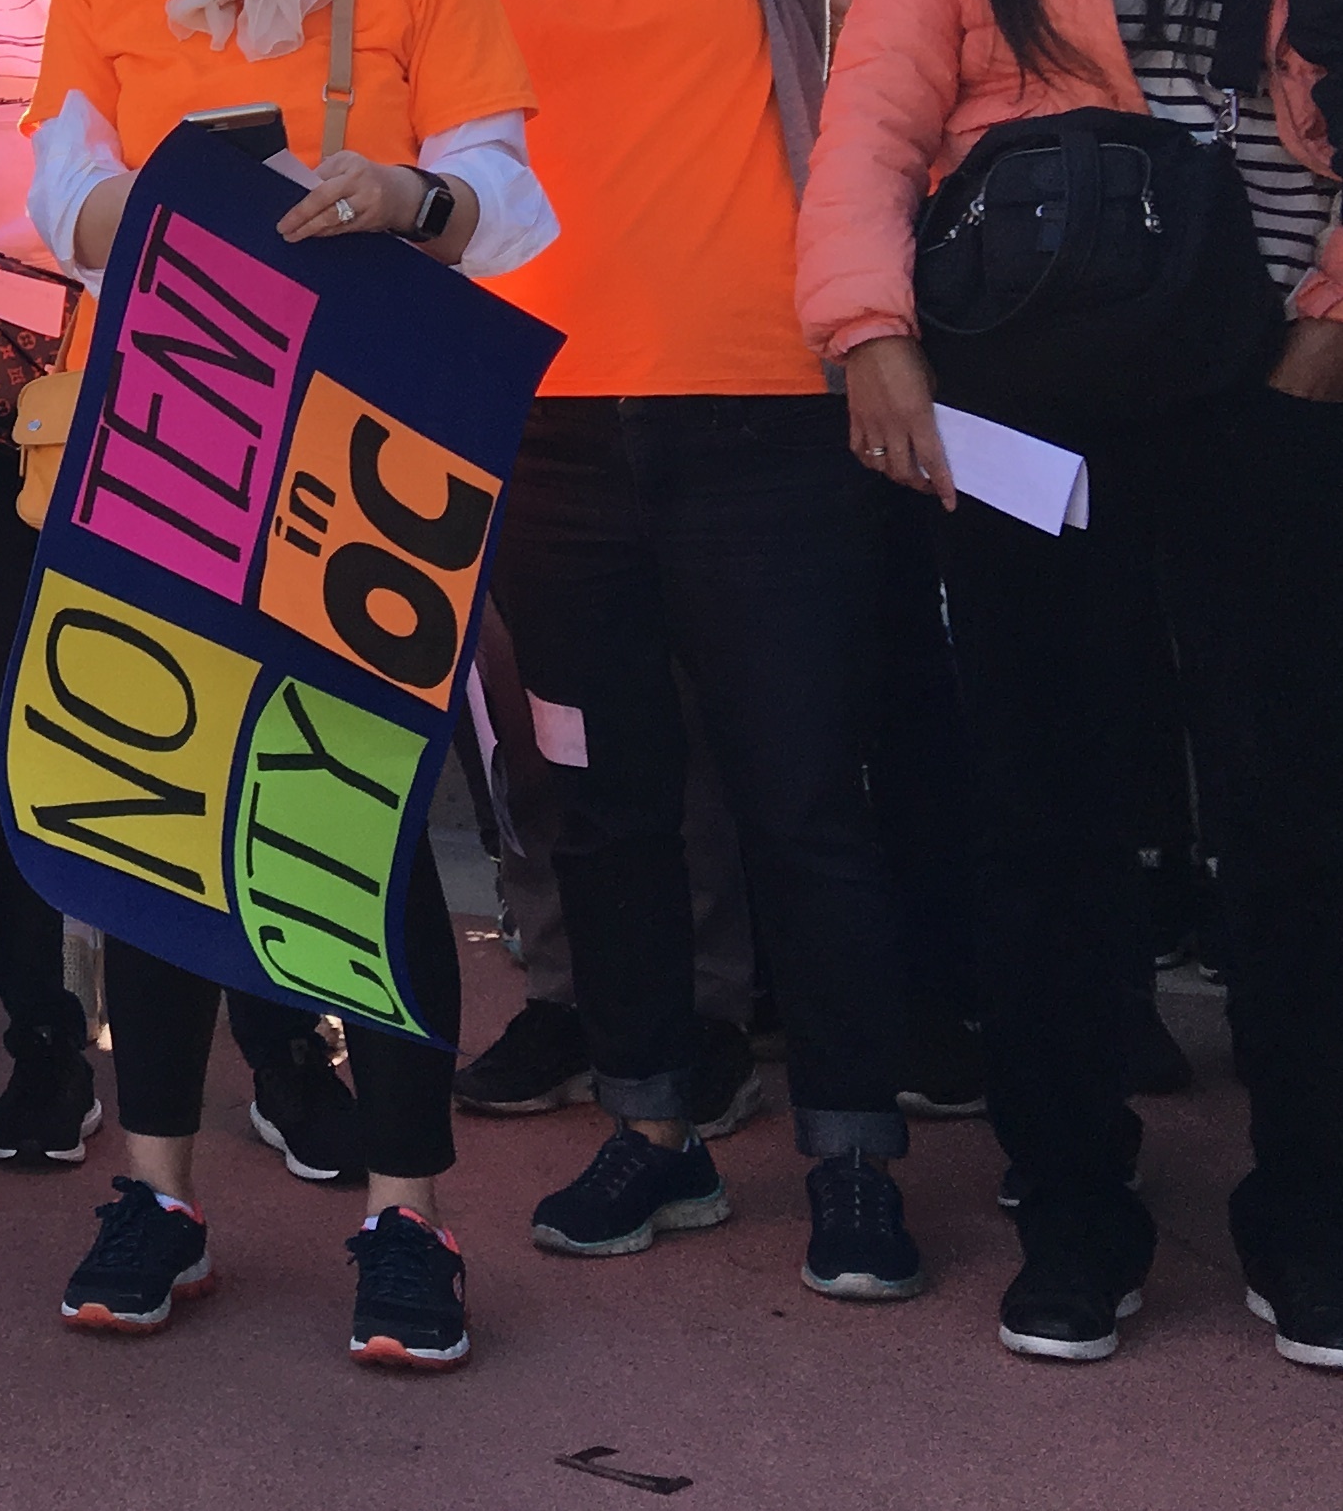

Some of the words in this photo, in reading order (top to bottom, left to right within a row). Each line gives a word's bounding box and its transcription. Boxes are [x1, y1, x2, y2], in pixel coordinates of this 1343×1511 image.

[79, 203, 290, 563] TENT
[275, 469, 336, 558] in
[324, 414, 495, 689] OC
[23, 607, 206, 896] NO
[248, 680, 407, 1027] CITY
